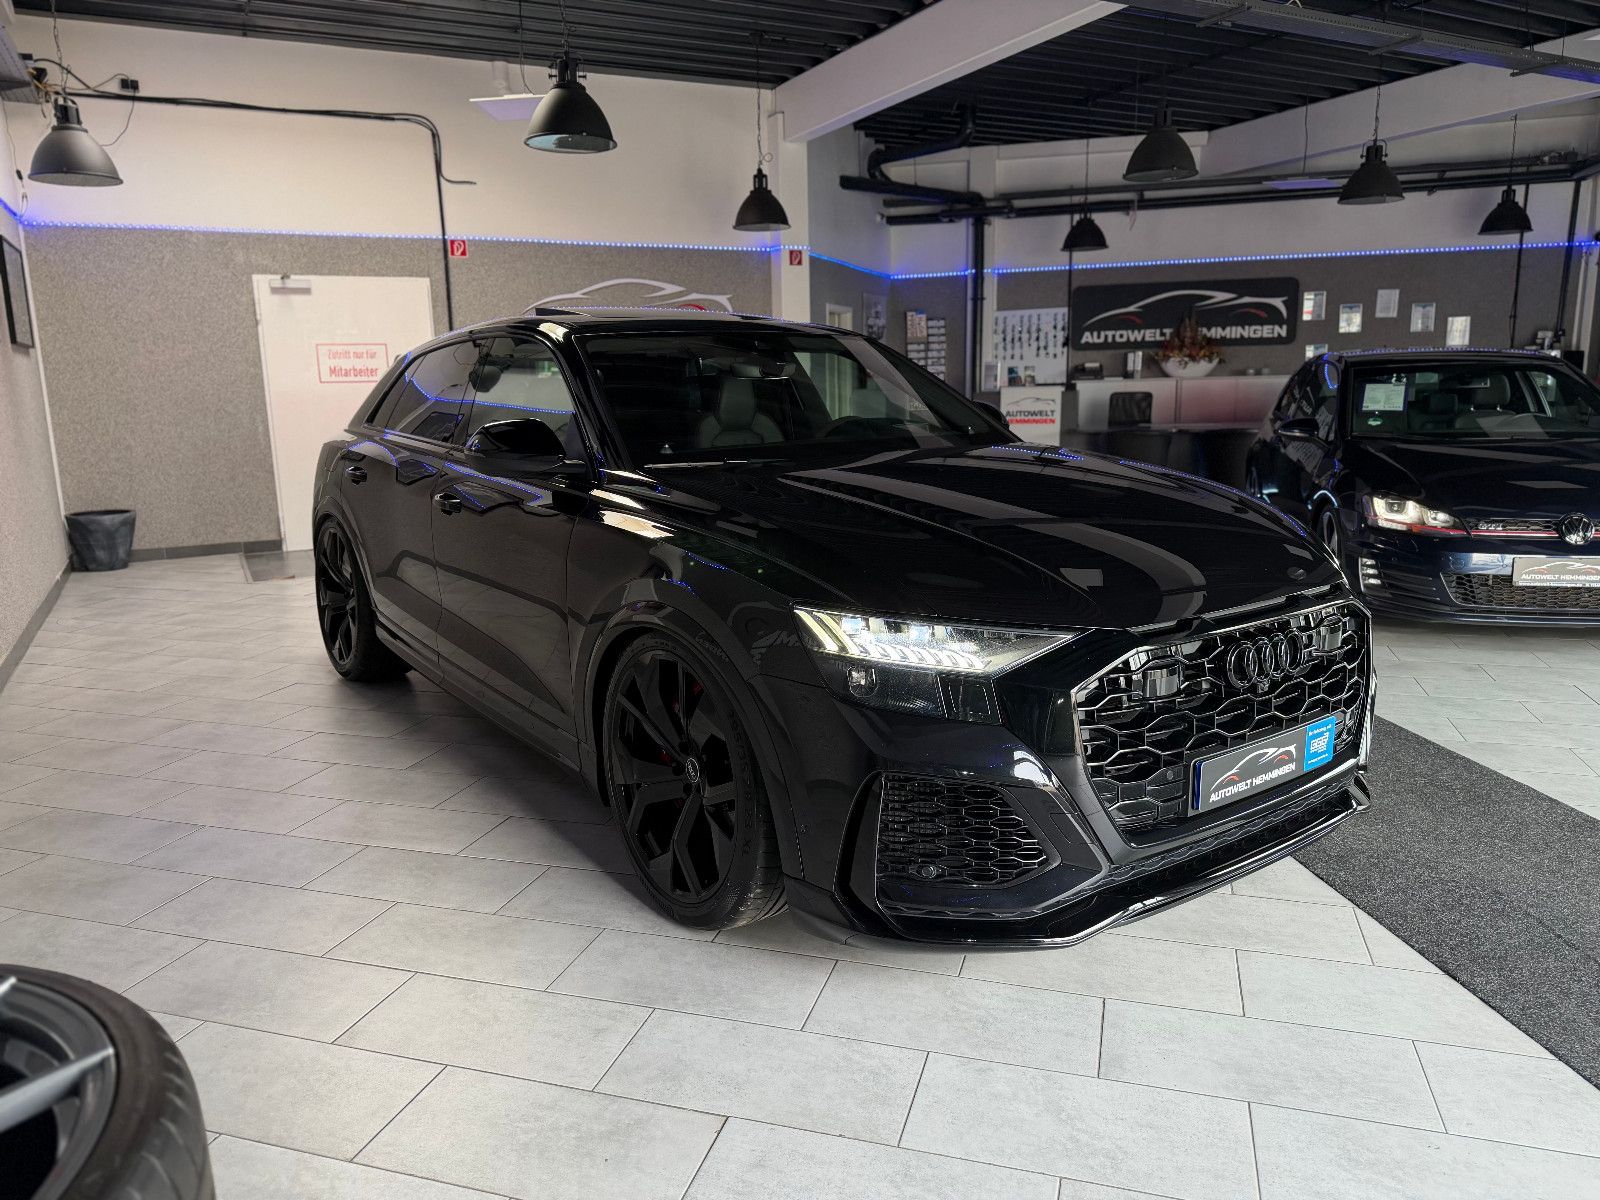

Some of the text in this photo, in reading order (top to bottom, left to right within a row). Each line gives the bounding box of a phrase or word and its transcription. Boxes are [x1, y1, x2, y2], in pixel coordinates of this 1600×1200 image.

[1079, 325, 1288, 344] AUTOWELT MMINGEN
[327, 349, 351, 360] Zutritt
[352, 351, 364, 359] nur
[329, 365, 378, 377] Mitarbeiter
[1209, 761, 1296, 803] AUTOWELT HEMMINGEN
